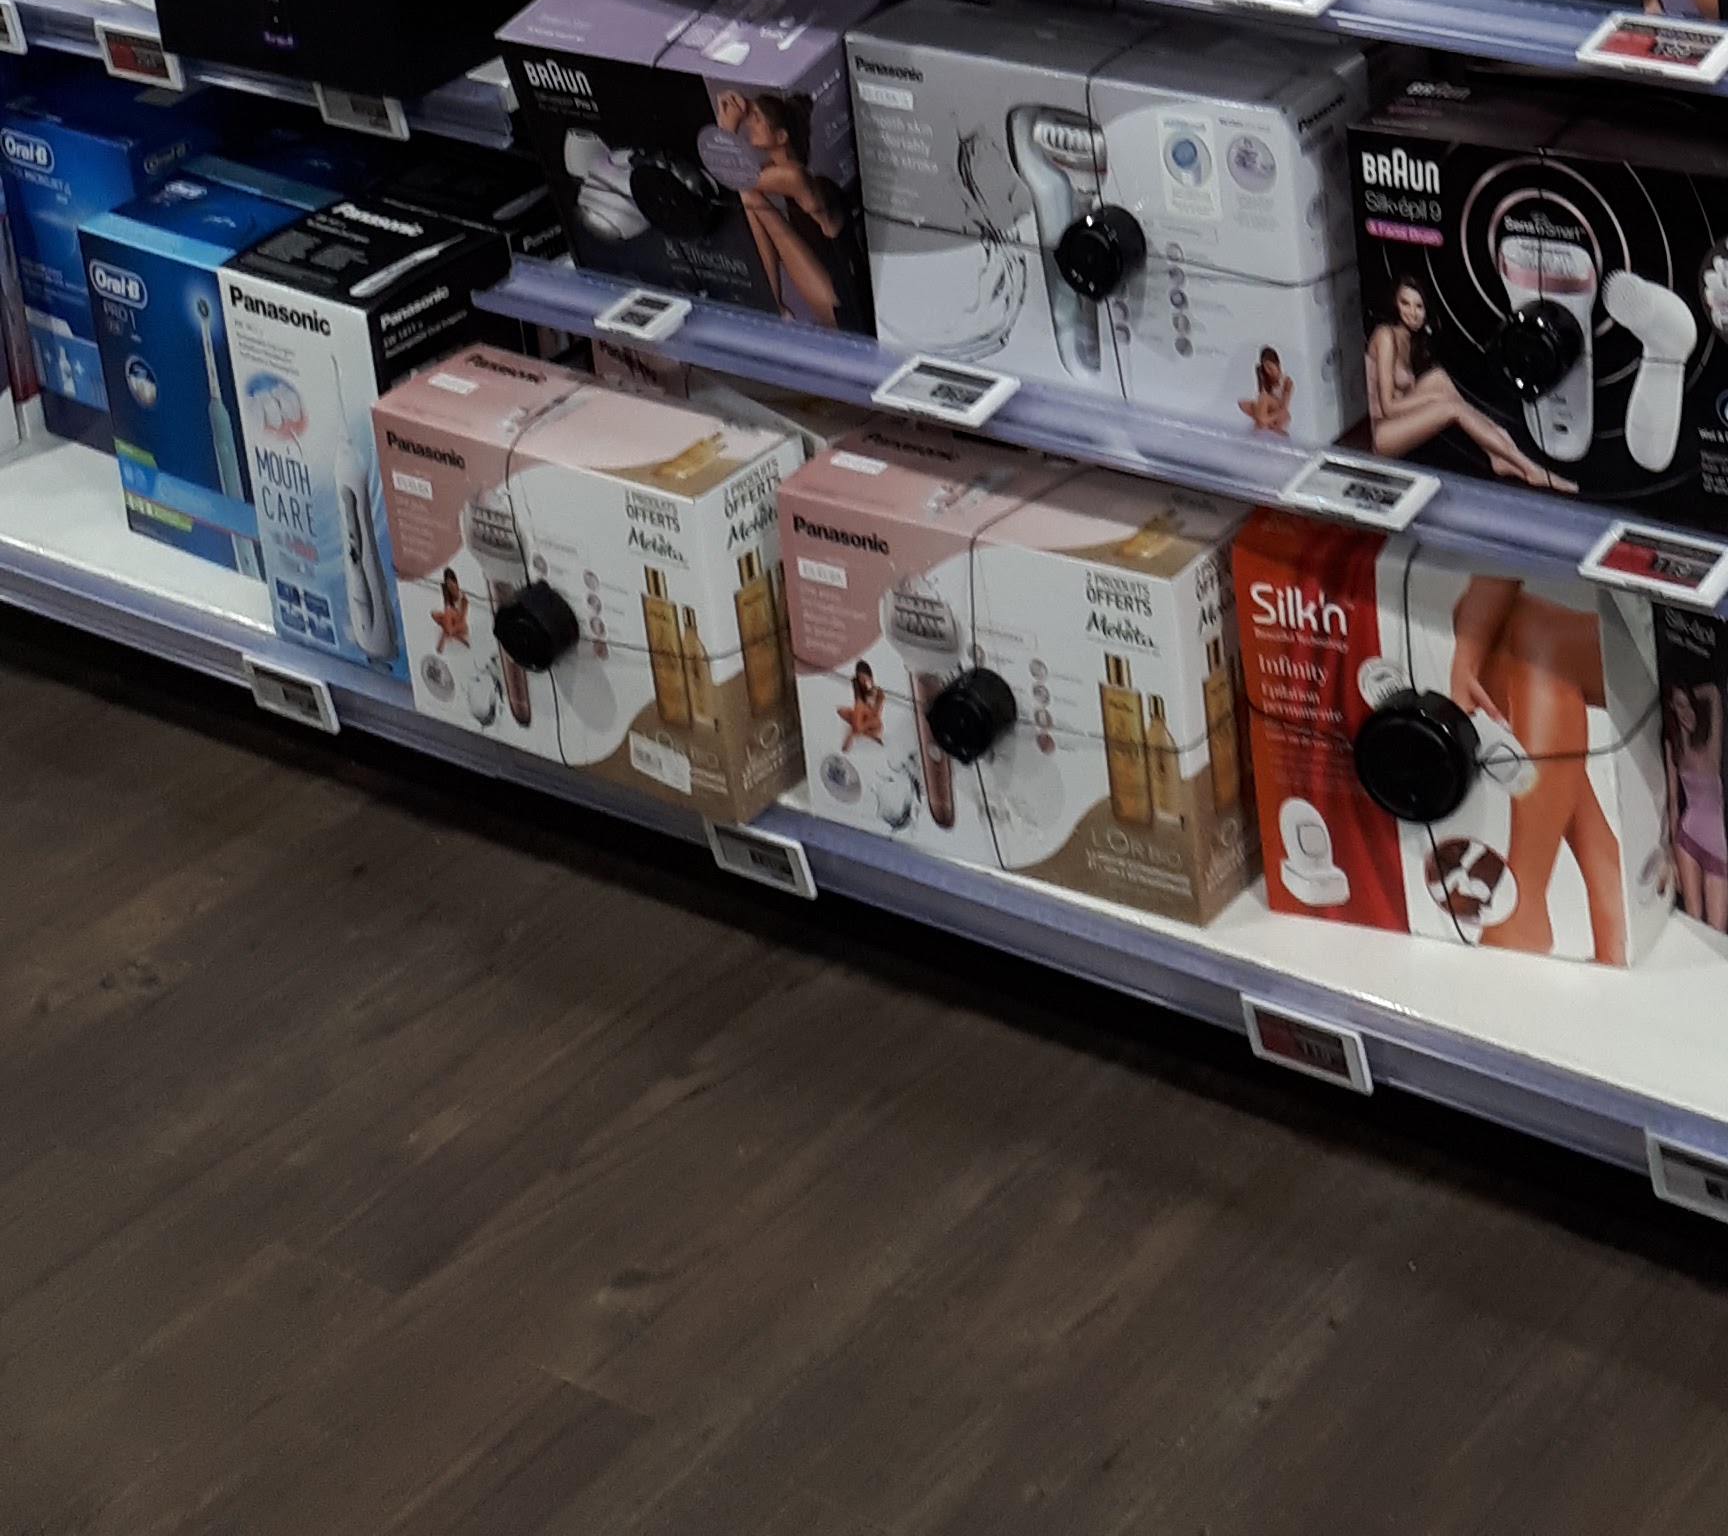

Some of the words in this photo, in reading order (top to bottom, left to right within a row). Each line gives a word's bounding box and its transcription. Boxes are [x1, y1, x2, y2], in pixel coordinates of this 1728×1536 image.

[524, 58, 594, 97] BRAUN
[1362, 146, 1440, 194] BRAUN
[92, 265, 142, 301] Oral-B
[229, 285, 331, 336] Panasonic
[386, 431, 466, 469] Panasonic
[255, 446, 312, 498] MOUTH
[625, 503, 681, 533] OFFERTS
[792, 514, 891, 557] Panasonic
[1085, 587, 1152, 617] OFFERTS
[1250, 582, 1348, 636] Silk'n
[1258, 653, 1328, 687] Infinity
